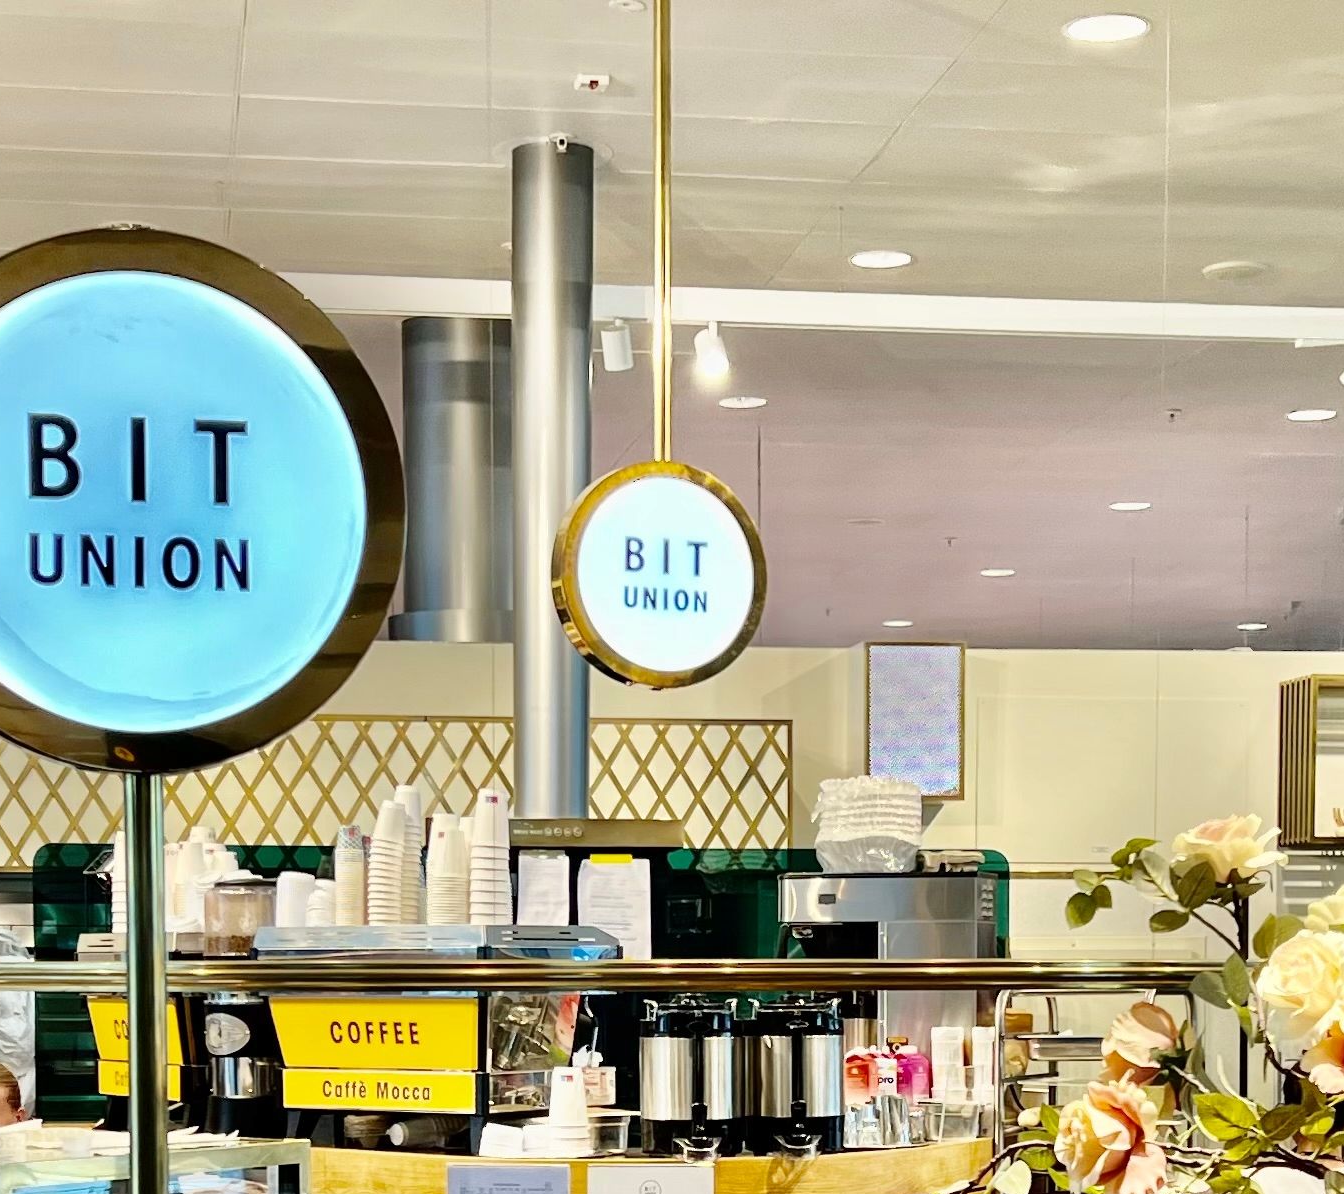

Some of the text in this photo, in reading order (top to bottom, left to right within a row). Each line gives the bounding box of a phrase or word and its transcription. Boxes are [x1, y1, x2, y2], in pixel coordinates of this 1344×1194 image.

[28, 413, 248, 506] BIT
[29, 533, 250, 592] UNION
[625, 536, 708, 577] BIT
[624, 586, 707, 612] UNION
[330, 1021, 420, 1044] COFFEE
[322, 1080, 430, 1100] Caffè Mocca
